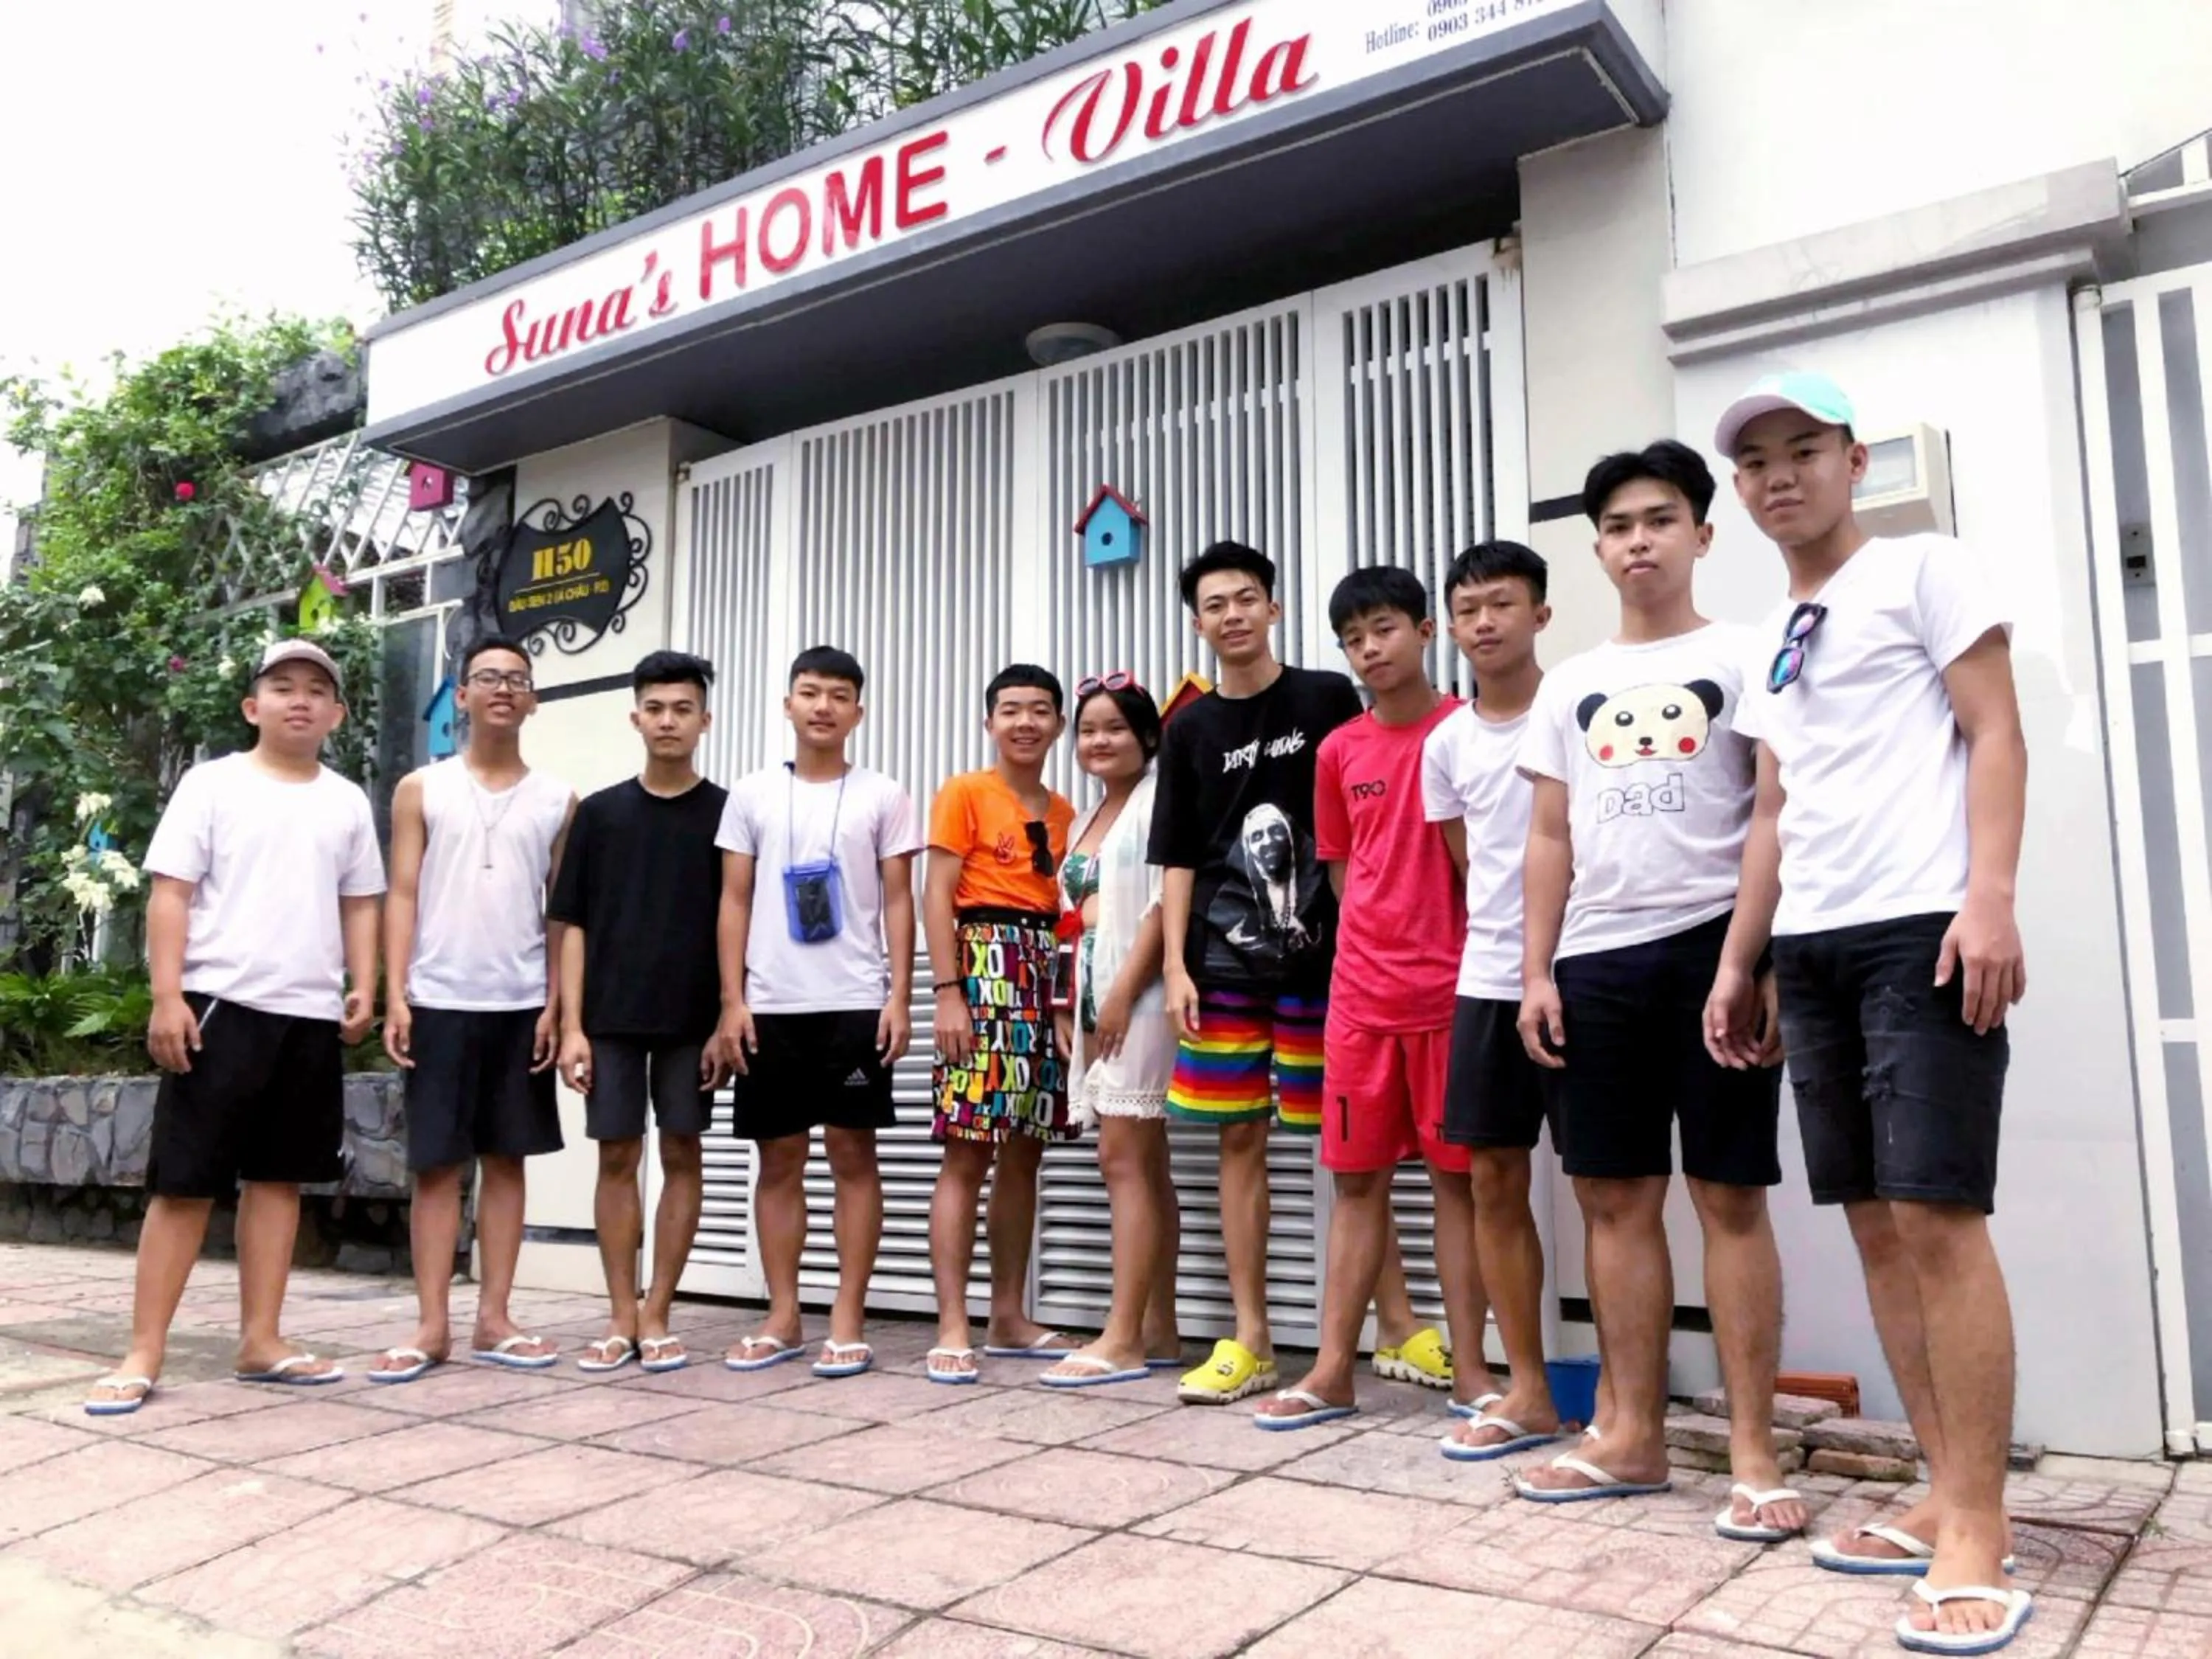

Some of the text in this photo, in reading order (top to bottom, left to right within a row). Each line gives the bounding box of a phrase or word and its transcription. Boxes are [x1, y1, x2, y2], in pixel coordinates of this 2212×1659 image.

[1365, 20, 1420, 54] Hotline:
[1427, 13, 1469, 41] 0903
[484, 249, 679, 377] Suna's
[699, 130, 950, 300] HOME
[1041, 16, 1320, 164] Villa
